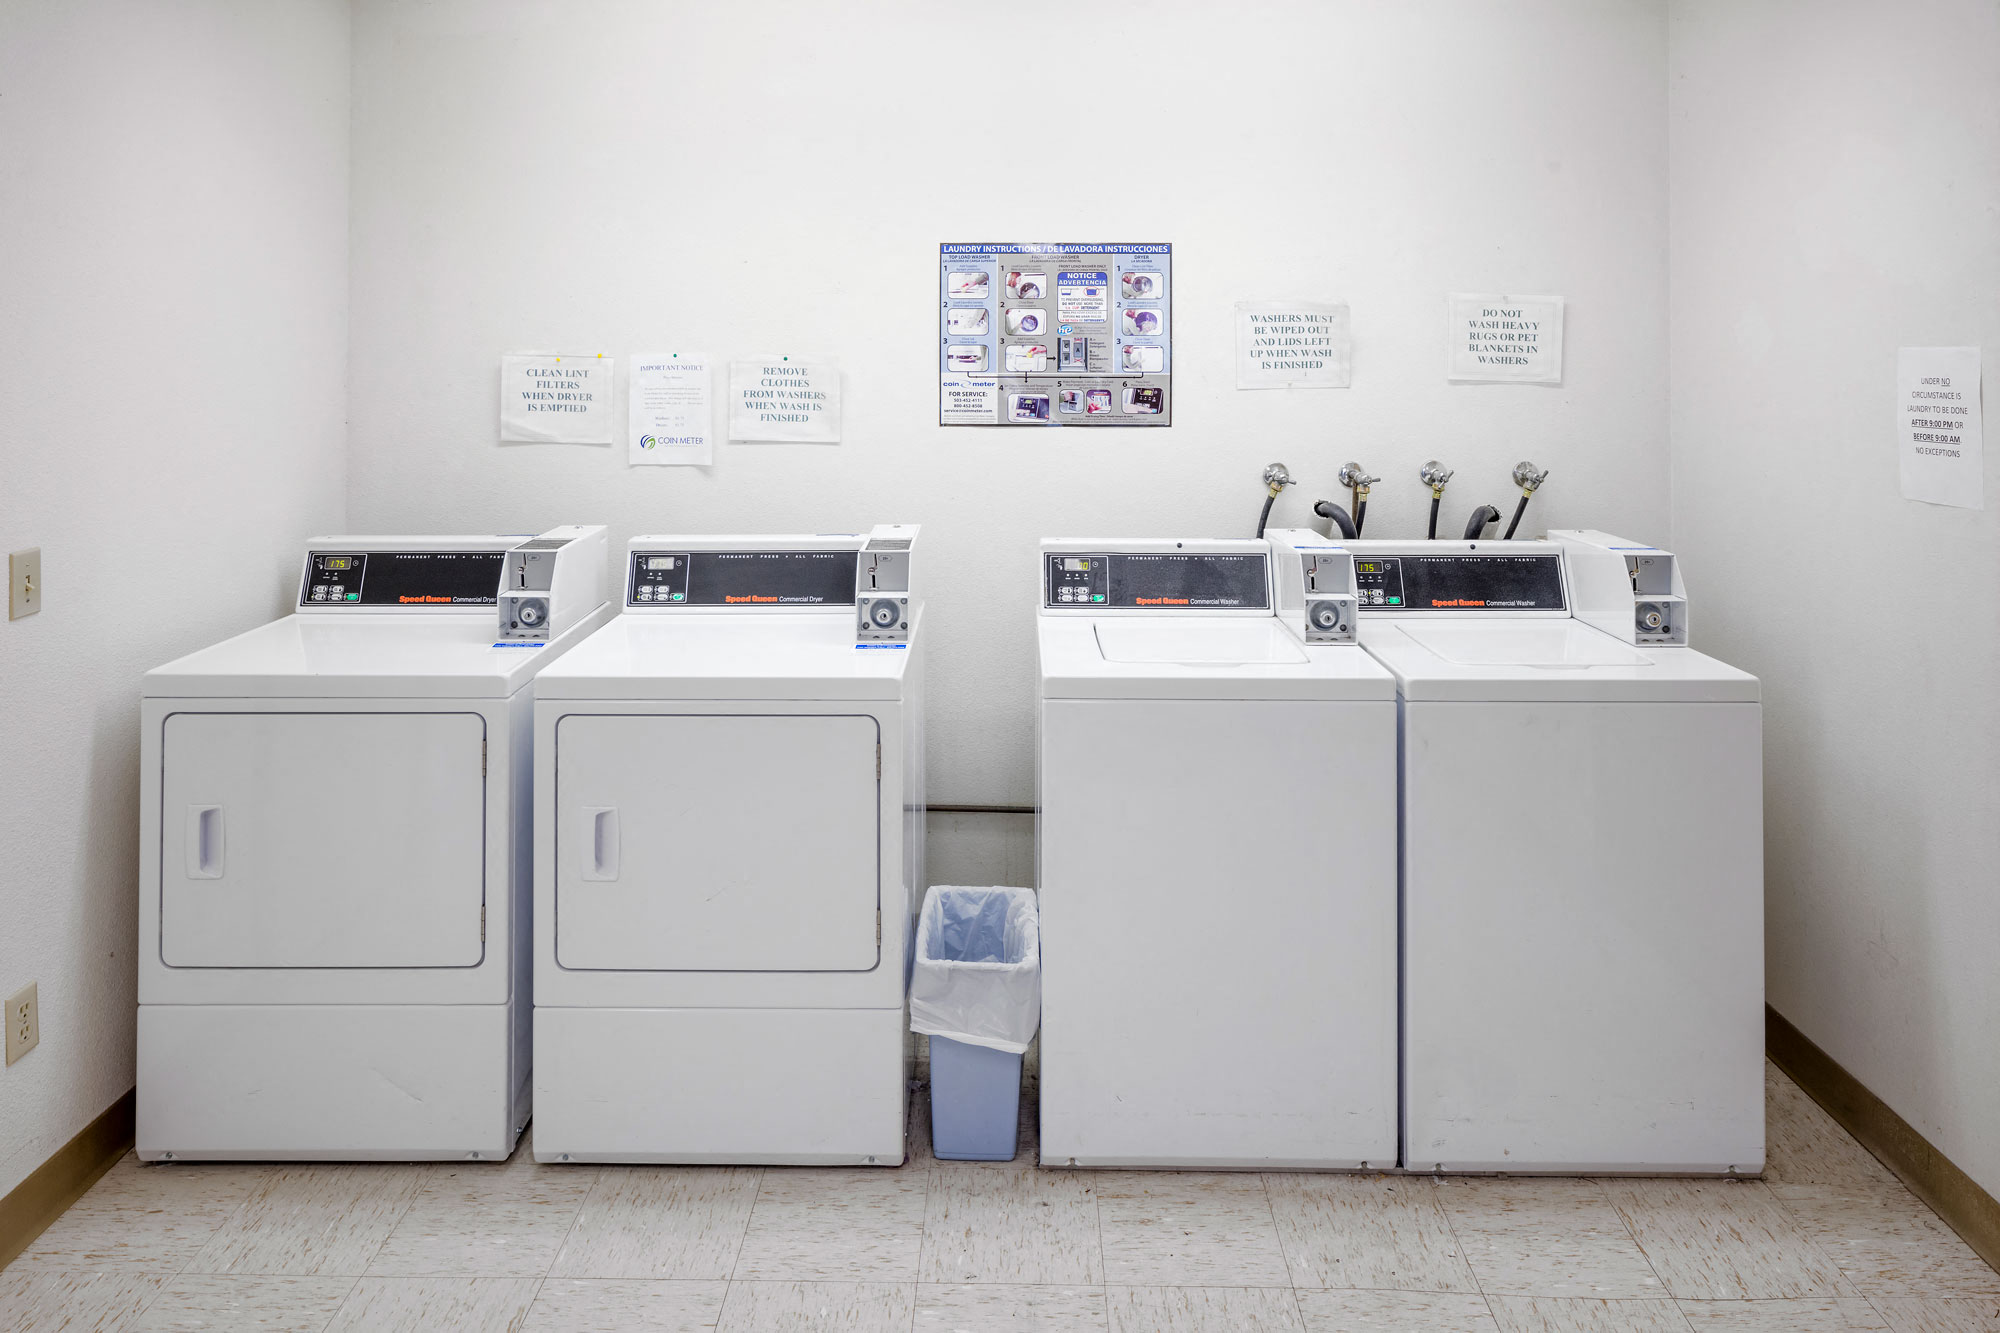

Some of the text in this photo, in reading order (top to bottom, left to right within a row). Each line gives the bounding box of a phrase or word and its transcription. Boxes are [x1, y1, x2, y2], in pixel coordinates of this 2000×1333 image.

[1501, 309, 1523, 318] NOT
[1304, 315, 1334, 323] MUST
[1502, 322, 1539, 330] HEAVY
[1469, 332, 1497, 340] RUGS
[1518, 334, 1538, 342] PET
[1469, 344, 1524, 353] BLANKETS
[1478, 356, 1528, 365] WASHERS
[526, 368, 562, 377] CLEAN
[763, 368, 808, 376] REMOVE
[537, 380, 580, 389] FILTERS
[761, 379, 809, 387] CLOTHES
[557, 393, 592, 401] DRYER
[777, 391, 826, 399] WASHERS
[1912, 391, 1954, 400] CIRCUMSTANCE
[540, 404, 587, 412] EMPTIED
[760, 414, 808, 422] FINISHED
[1925, 448, 1960, 458] EXCEPTIONS
[399, 595, 424, 604] Speed
